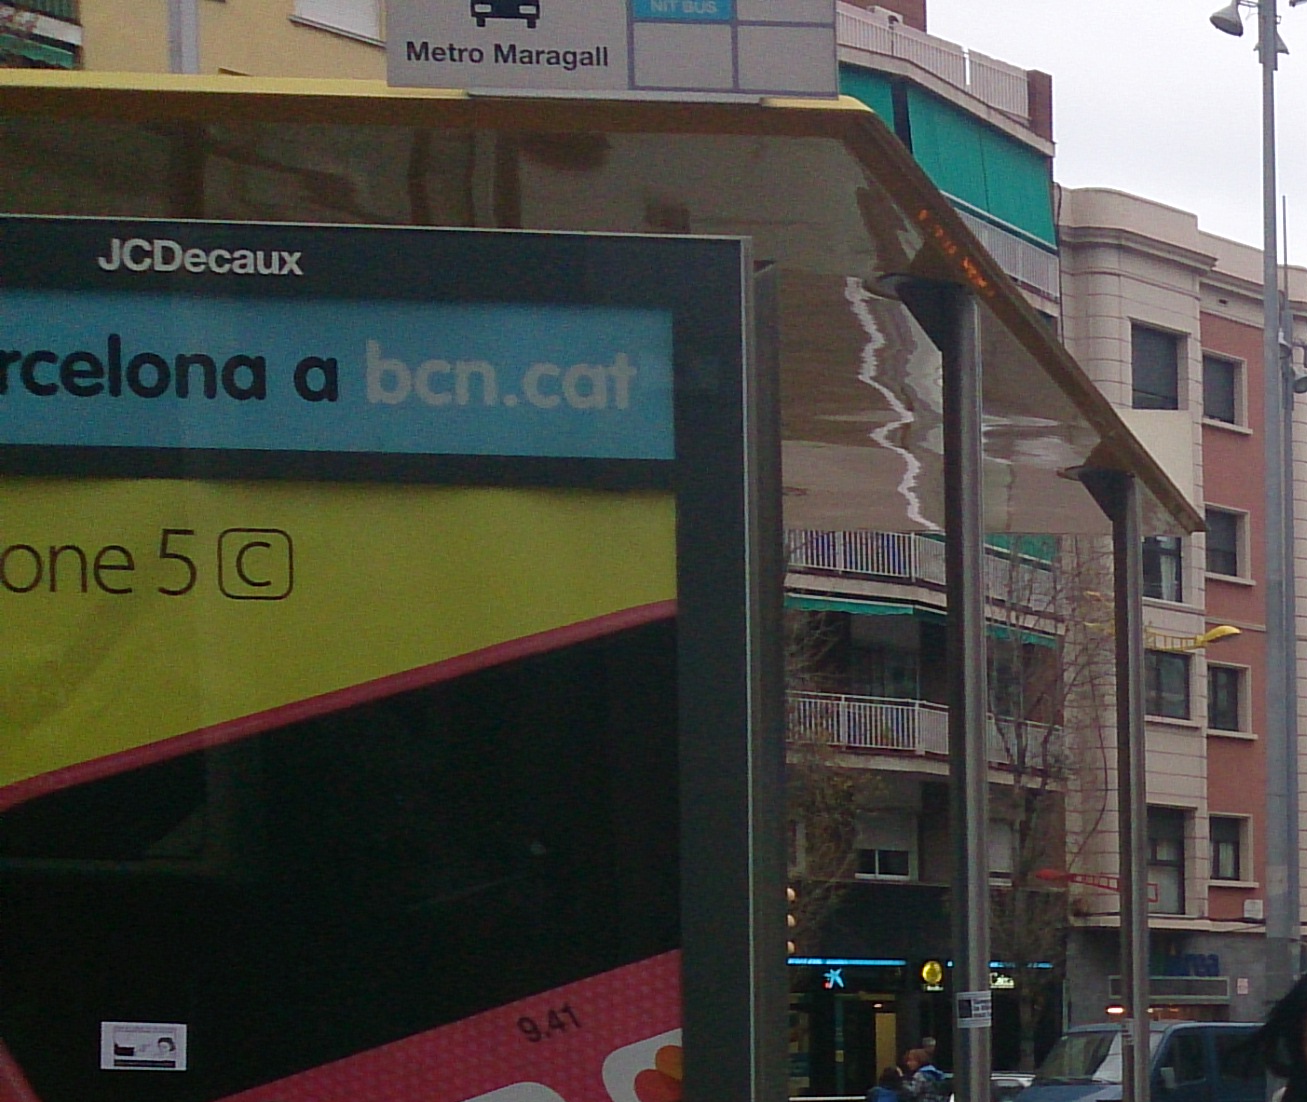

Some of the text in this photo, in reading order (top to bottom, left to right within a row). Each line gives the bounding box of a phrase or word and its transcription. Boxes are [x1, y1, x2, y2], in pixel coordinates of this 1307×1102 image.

[682, 0, 718, 14] BUS
[406, 41, 609, 71] Metro Maragall
[98, 238, 304, 276] JCDecaux
[293, 355, 339, 402] a
[366, 340, 637, 411] bcn.cat
[0, 543, 135, 595] one
[158, 528, 197, 596] 5
